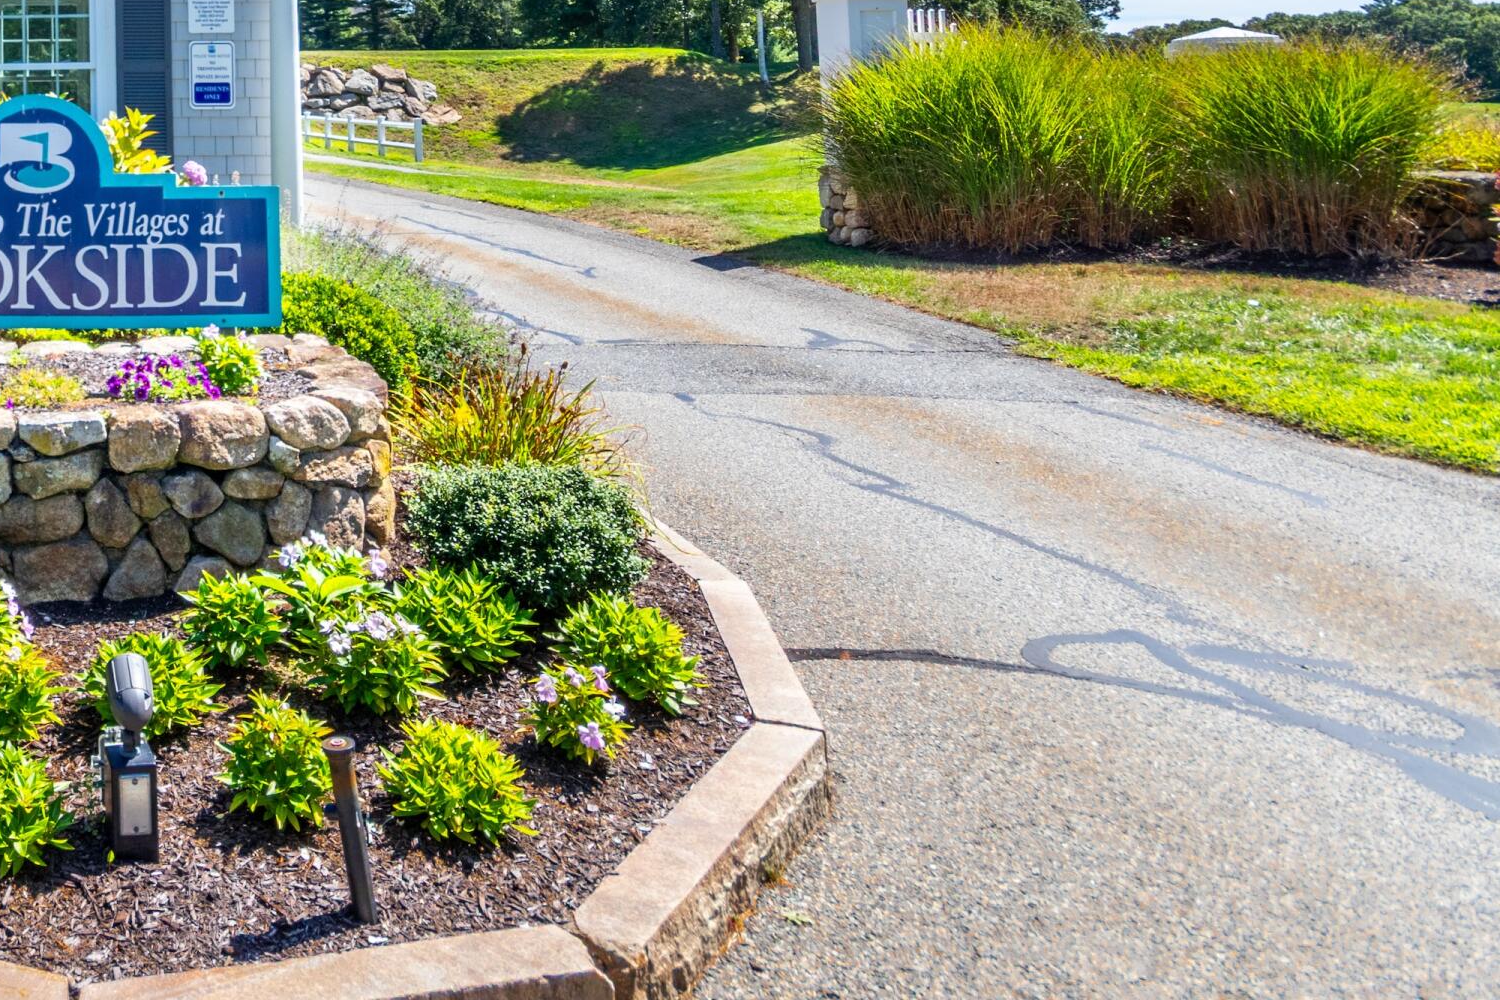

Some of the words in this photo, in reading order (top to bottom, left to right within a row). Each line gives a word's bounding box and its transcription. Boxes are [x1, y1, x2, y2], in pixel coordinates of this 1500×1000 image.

[17, 202, 72, 237] The
[84, 202, 189, 243] Villages
[201, 207, 225, 236] at
